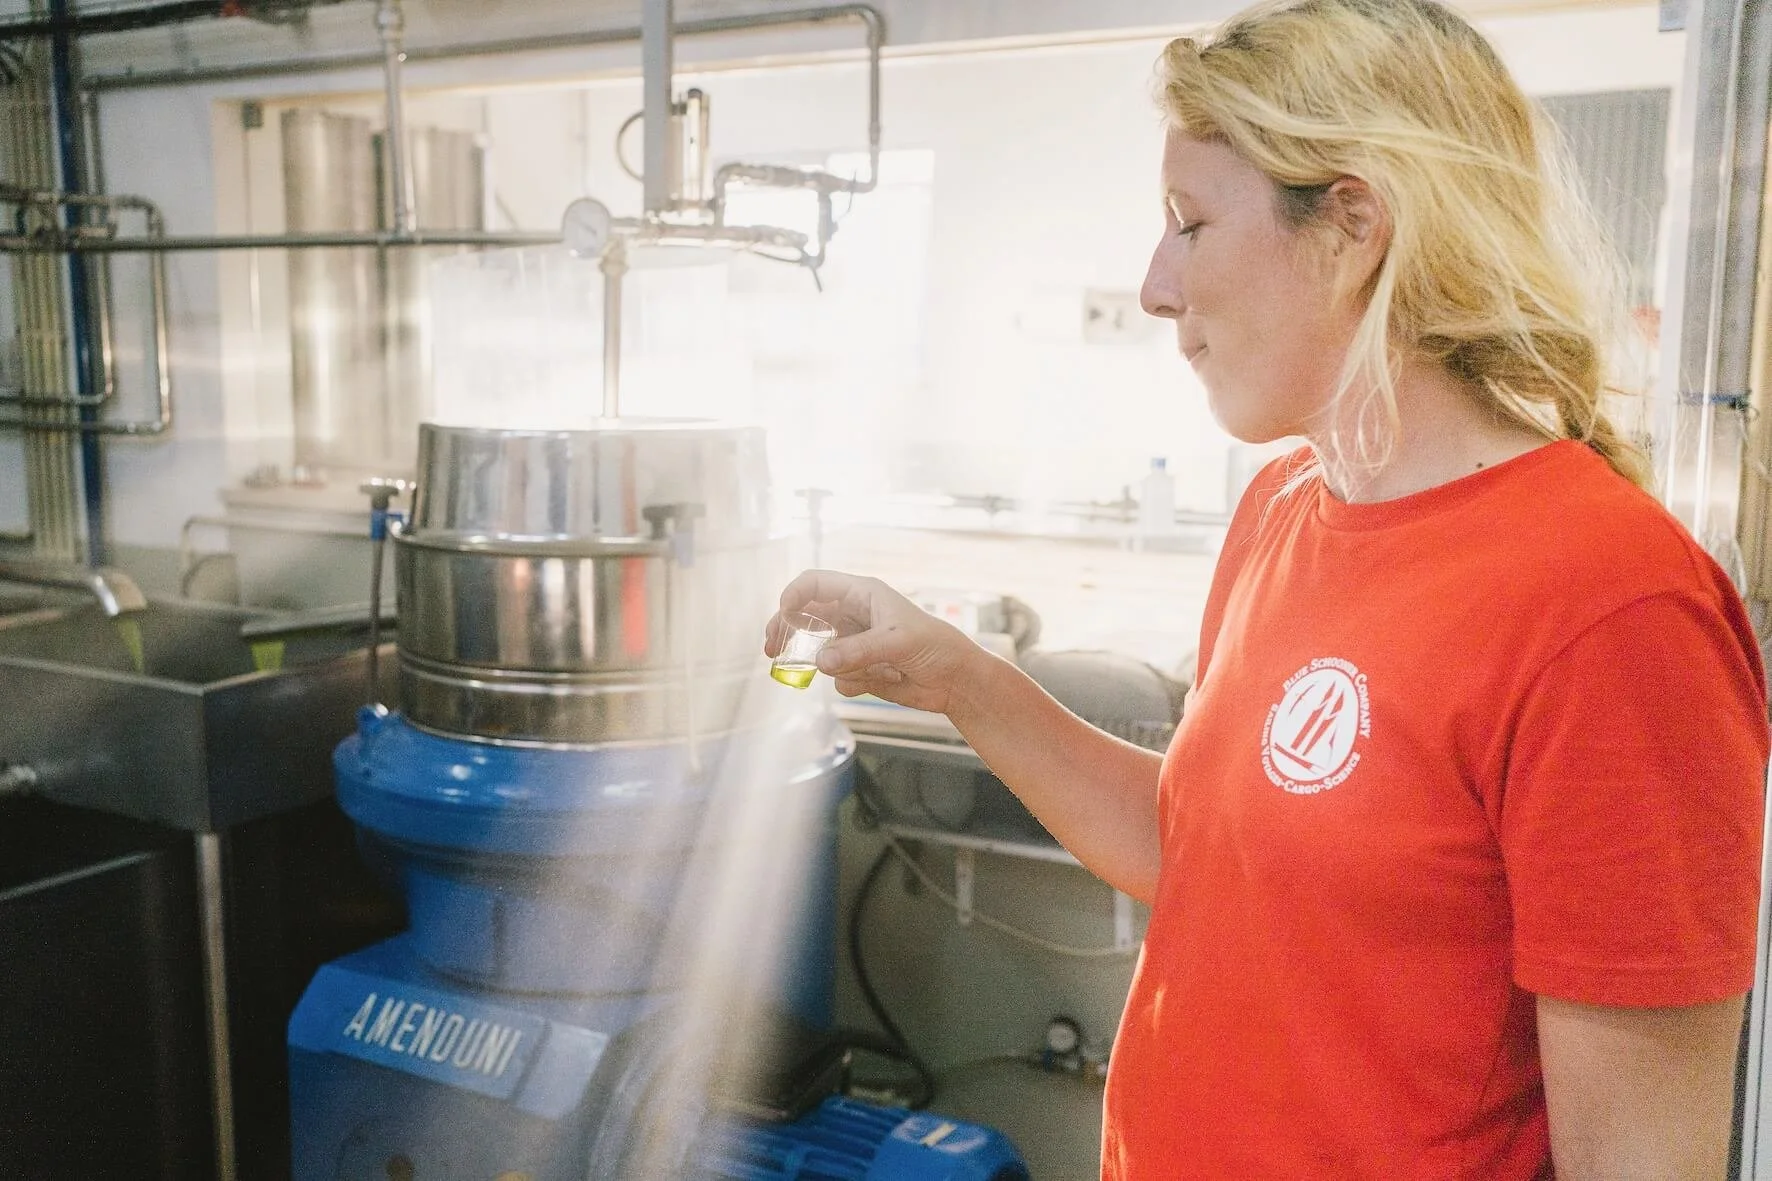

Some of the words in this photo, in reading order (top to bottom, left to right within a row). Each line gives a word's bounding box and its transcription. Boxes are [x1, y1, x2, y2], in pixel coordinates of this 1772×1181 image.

[1282, 666, 1310, 692] BLUE
[1354, 673, 1371, 739] COMPANY
[343, 992, 522, 1077] AMENDUNI
